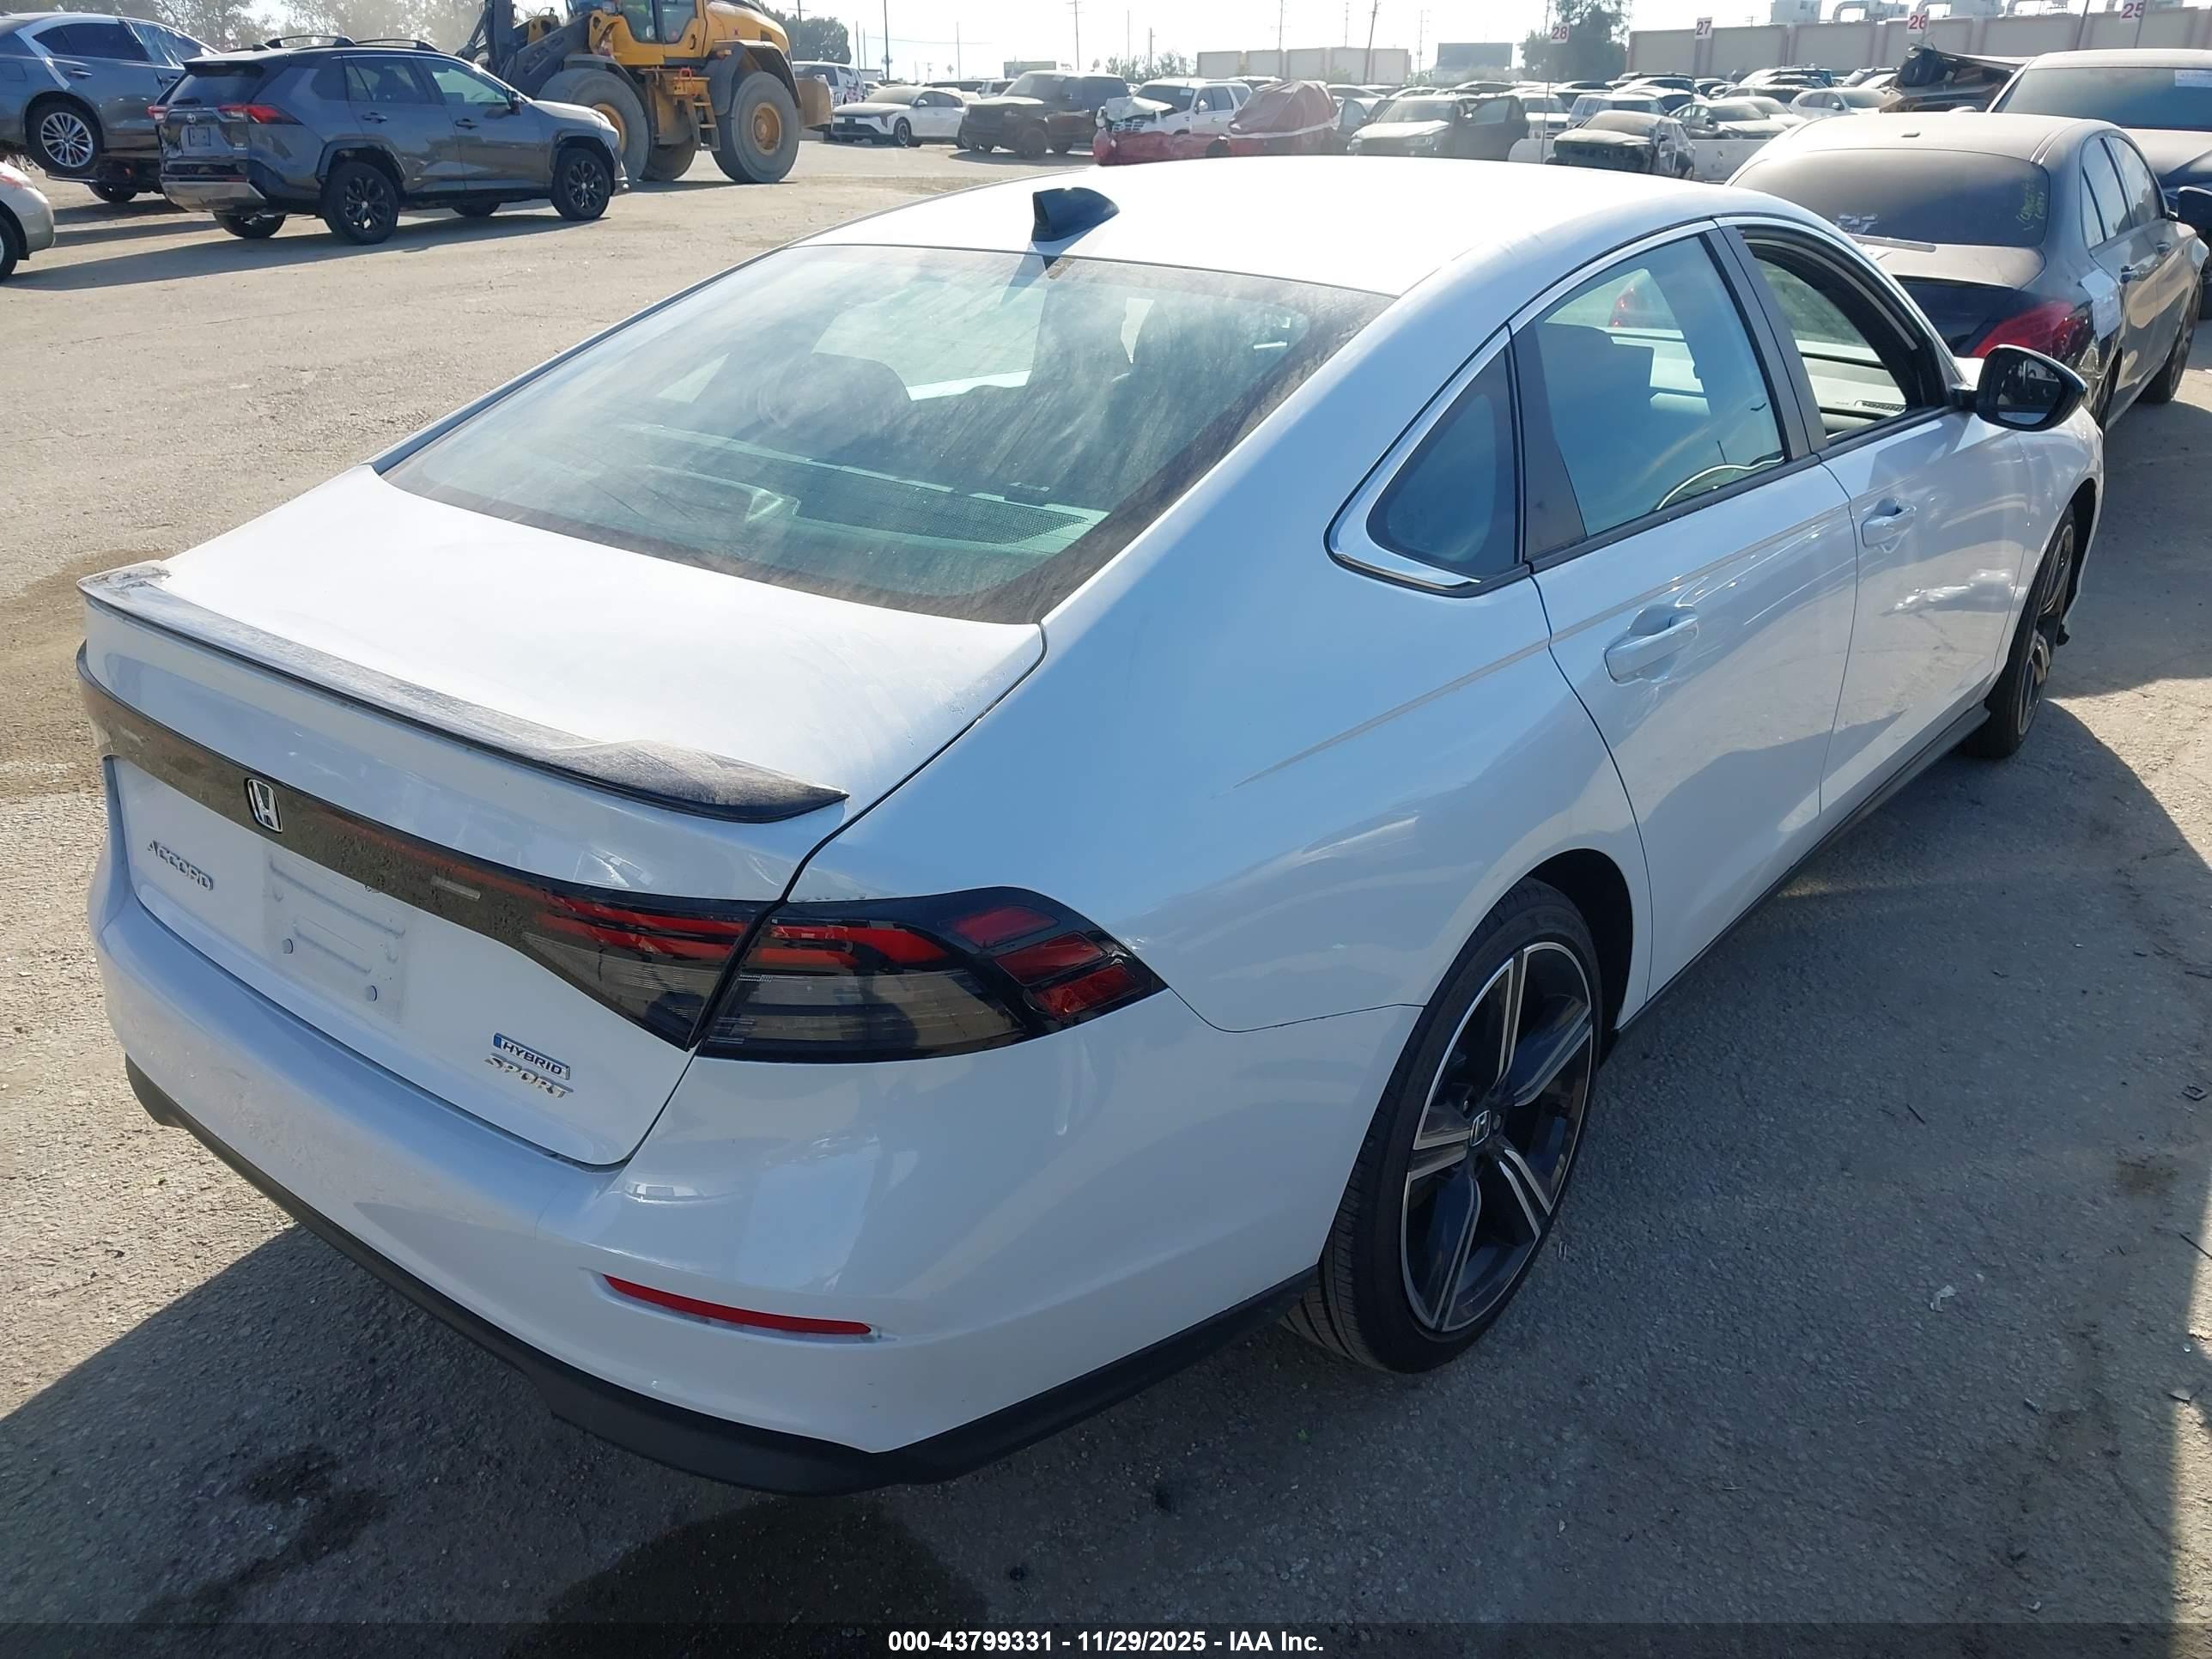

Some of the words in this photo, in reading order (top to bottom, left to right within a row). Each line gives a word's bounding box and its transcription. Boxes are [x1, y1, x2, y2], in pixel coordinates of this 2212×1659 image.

[2121, 3, 2144, 19] 25
[1696, 21, 1711, 35] 27
[1909, 15, 1927, 30] 26
[1552, 26, 1568, 40] 28
[147, 840, 214, 890] ACCORD
[502, 1041, 562, 1075] HYBRID
[483, 1053, 574, 1098] SPORT
